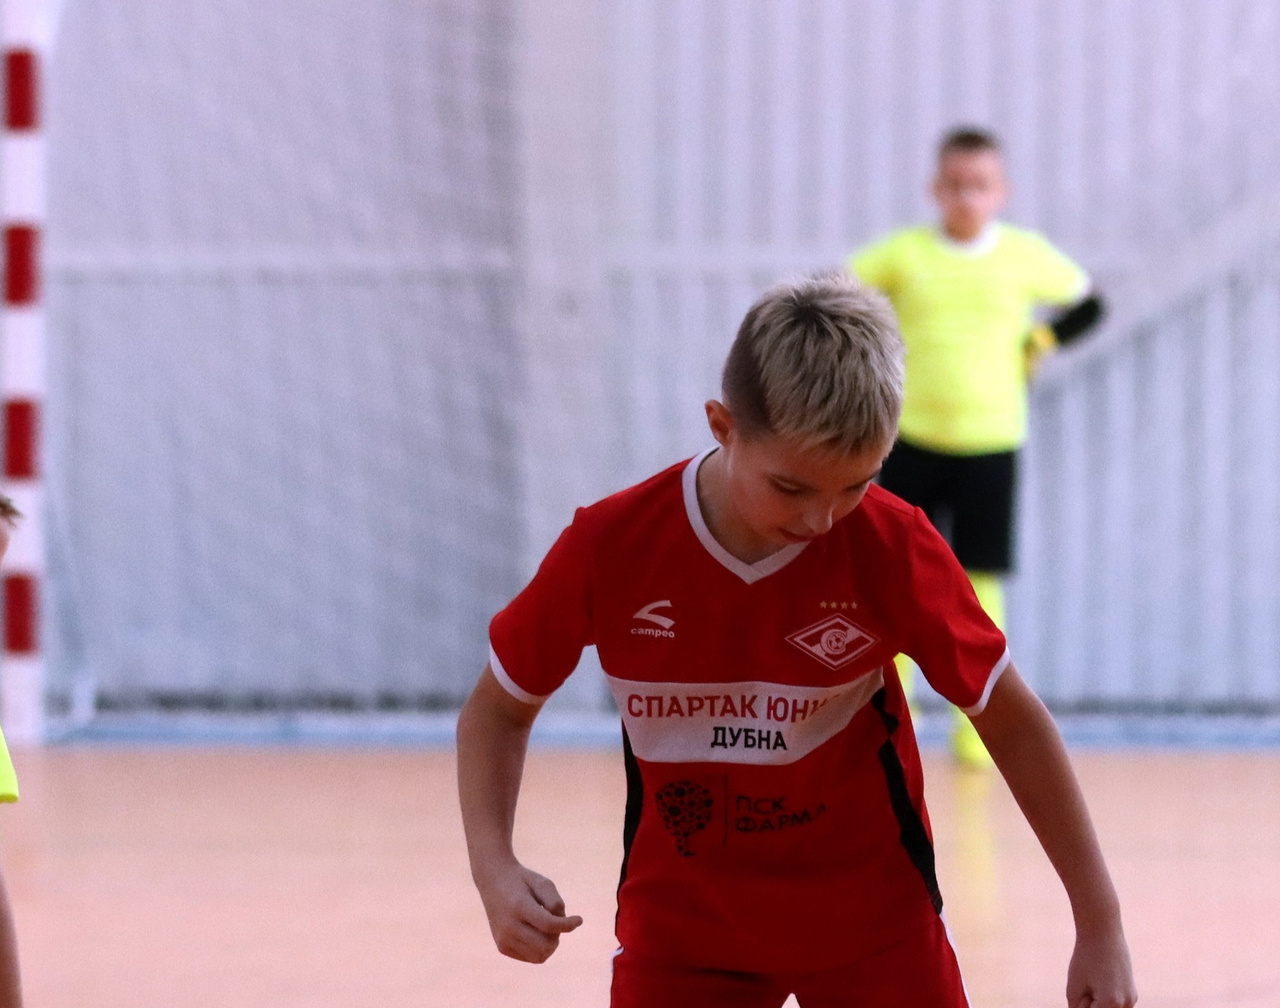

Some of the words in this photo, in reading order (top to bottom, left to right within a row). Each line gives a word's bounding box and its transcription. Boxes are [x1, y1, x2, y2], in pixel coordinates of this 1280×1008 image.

[630, 628, 676, 639] campeo
[627, 693, 759, 719] СПАРТАК
[710, 725, 788, 751] ДУБНА
